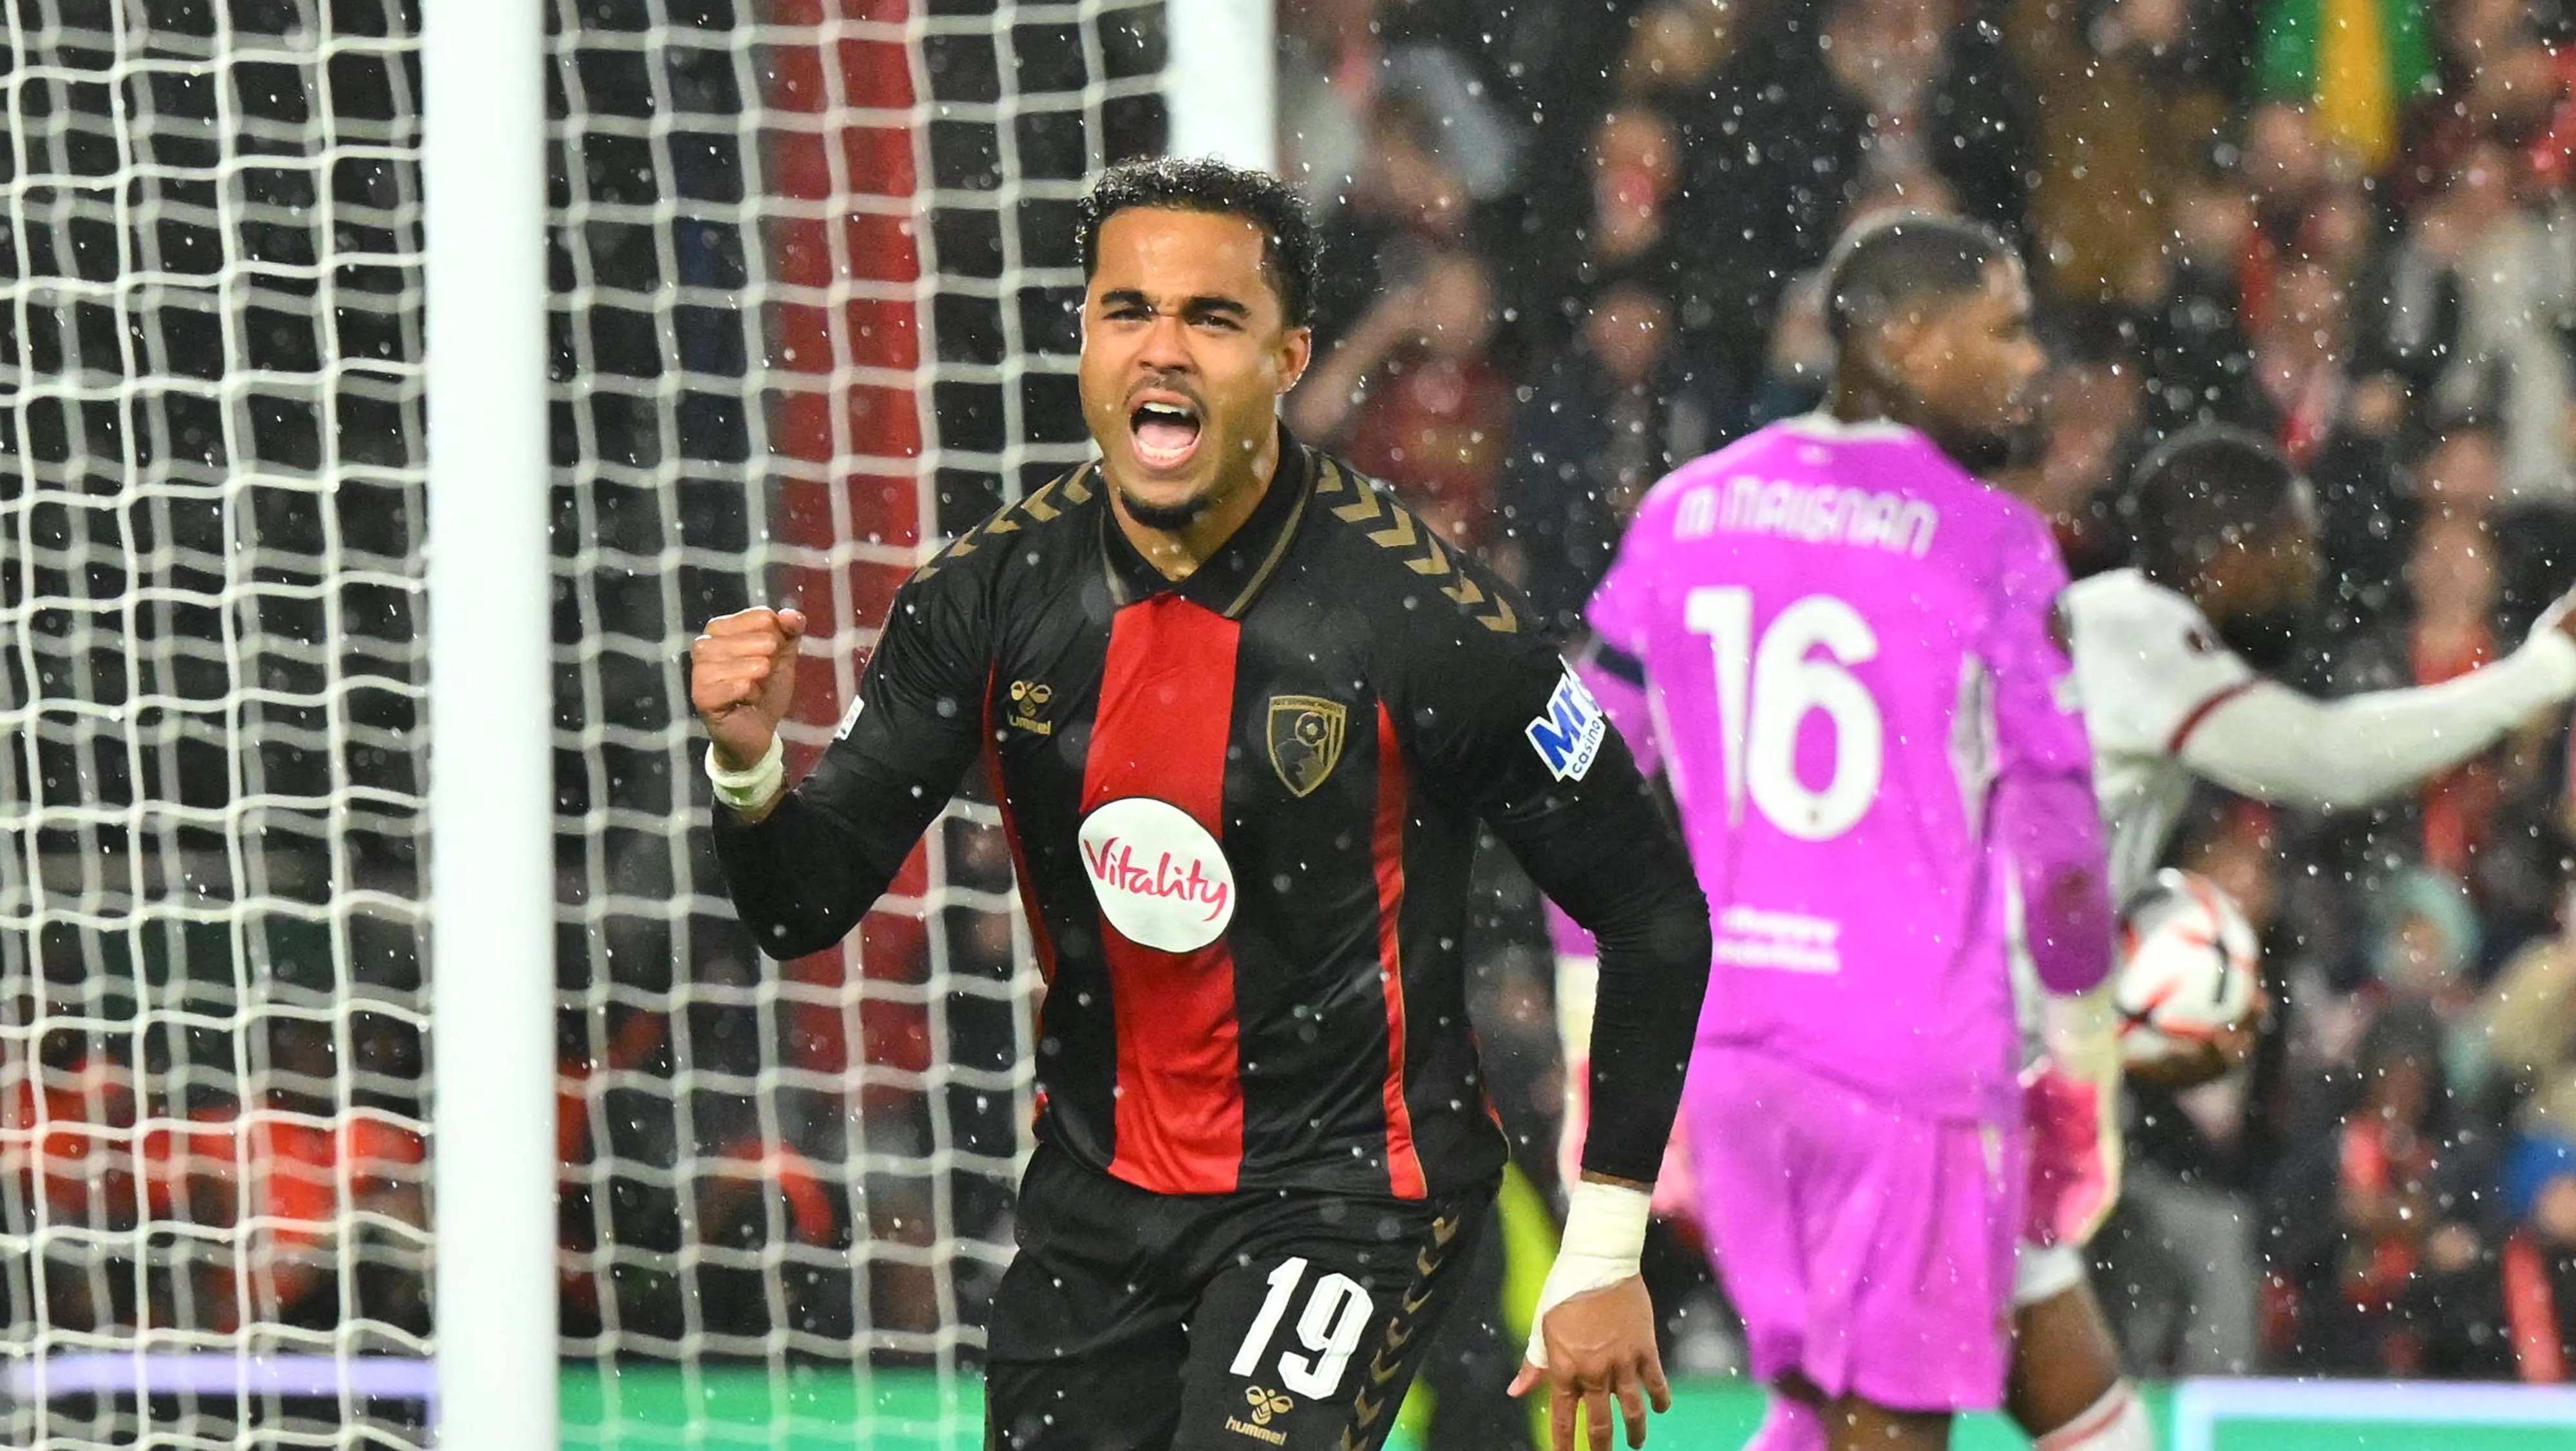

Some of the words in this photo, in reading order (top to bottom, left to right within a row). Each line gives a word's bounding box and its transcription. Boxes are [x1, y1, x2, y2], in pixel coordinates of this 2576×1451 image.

[1572, 719, 1601, 773] casino
[1685, 585, 1884, 842] 16
[1083, 837, 1227, 922] Vitality
[1229, 1256, 1374, 1400] 19
[1224, 1415, 1287, 1446] hummel
